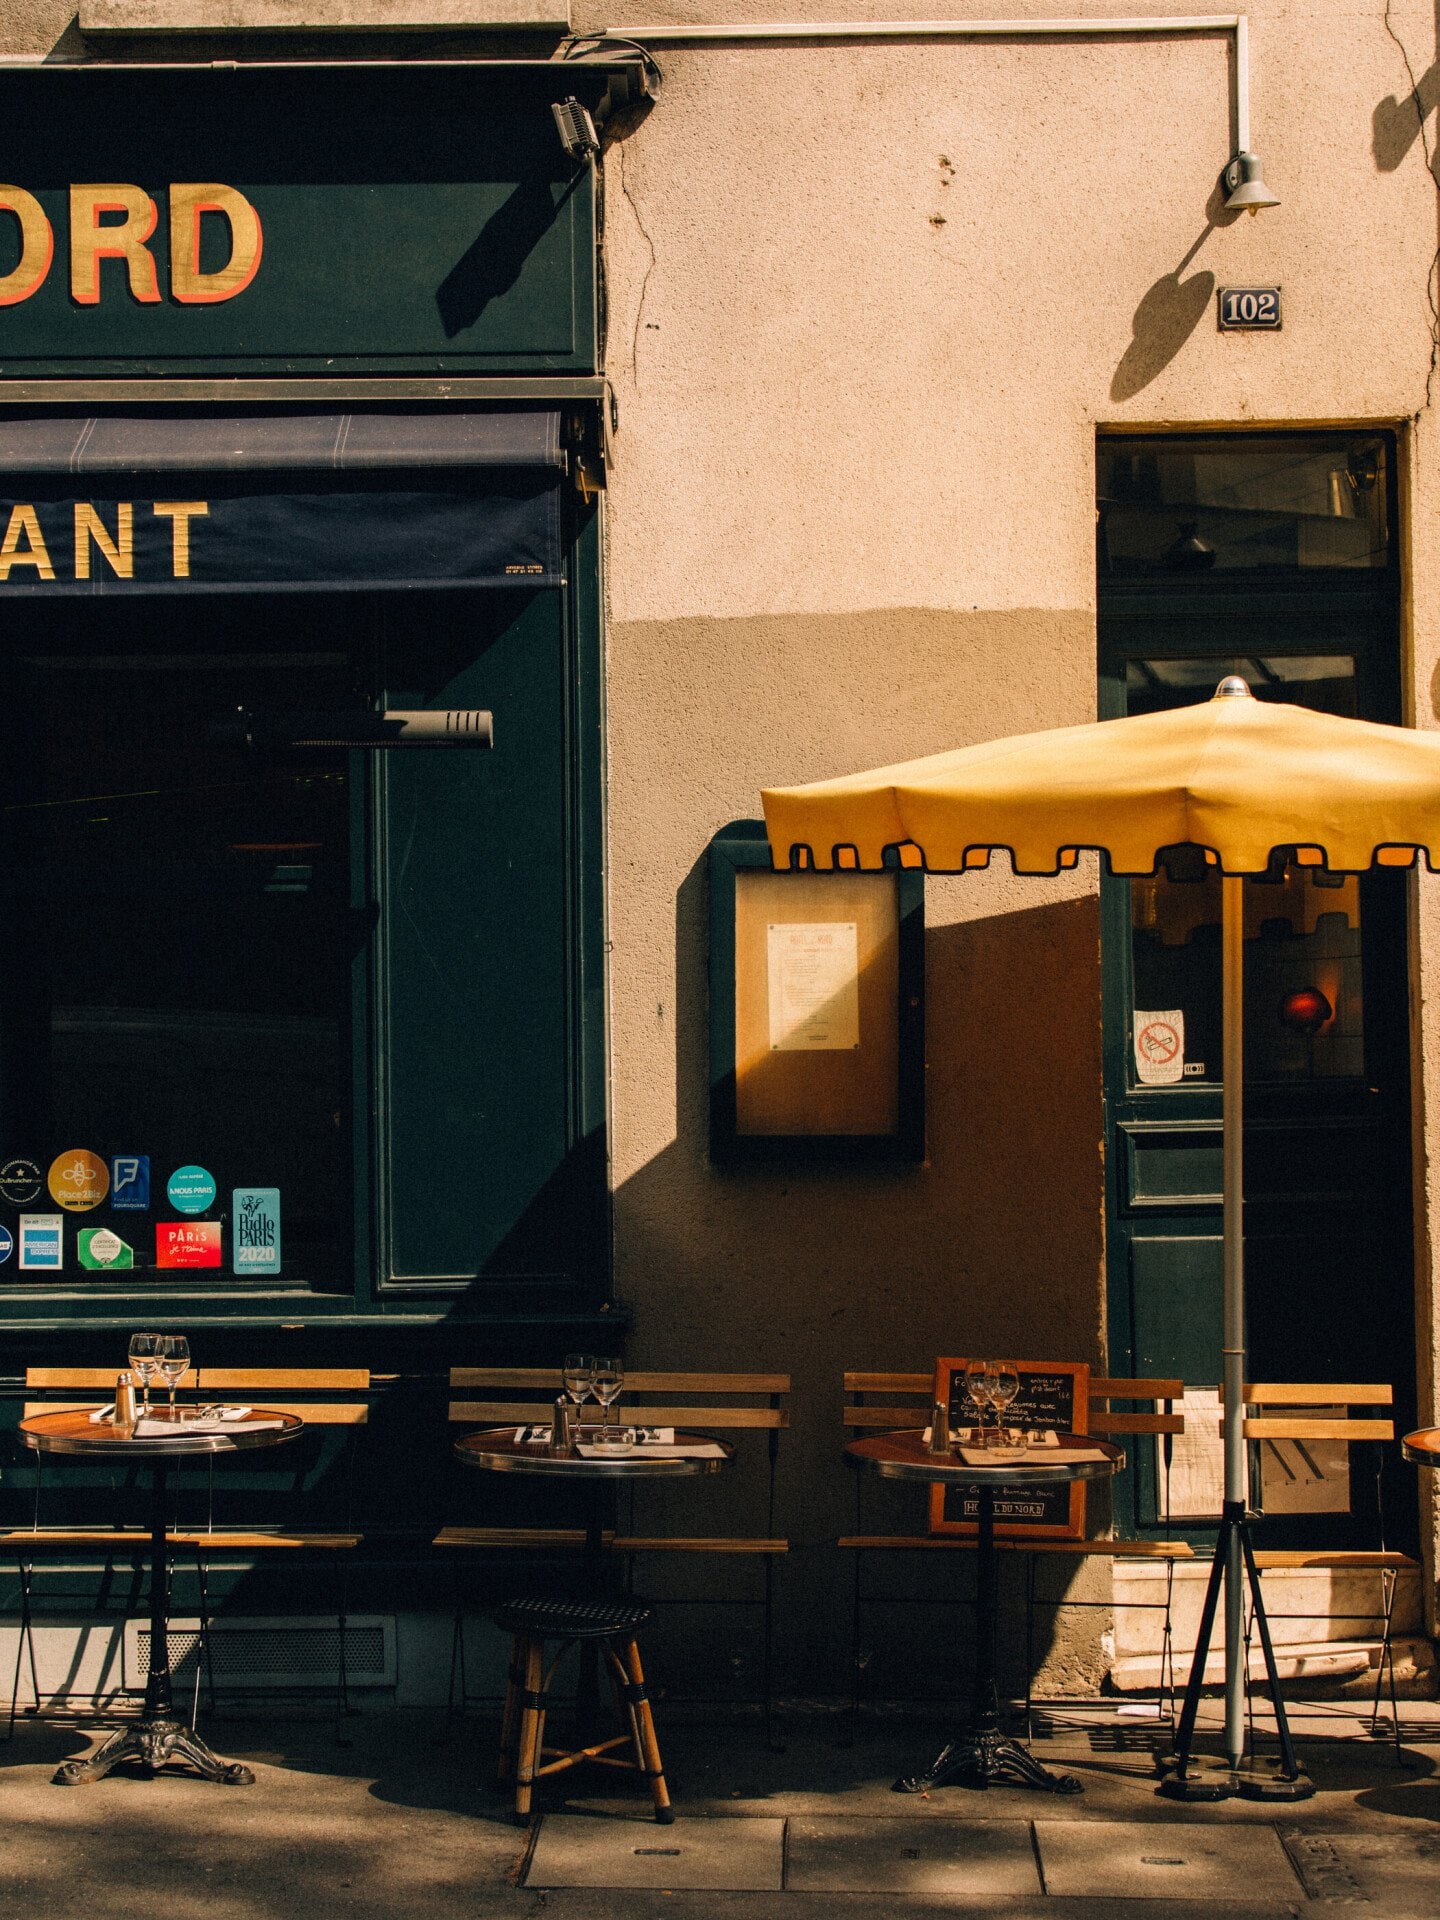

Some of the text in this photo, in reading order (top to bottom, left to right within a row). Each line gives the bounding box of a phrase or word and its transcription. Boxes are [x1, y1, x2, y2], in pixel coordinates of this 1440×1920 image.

[1227, 294, 1275, 320] 102
[0, 501, 208, 580] ANT
[58, 1189, 101, 1199] Place2Biz
[193, 1186, 213, 1194] PARIS
[238, 1229, 275, 1247] PARIS
[238, 1247, 276, 1262] 2020
[1002, 1505, 1013, 1513] DU
[1015, 1505, 1042, 1515] NORD
